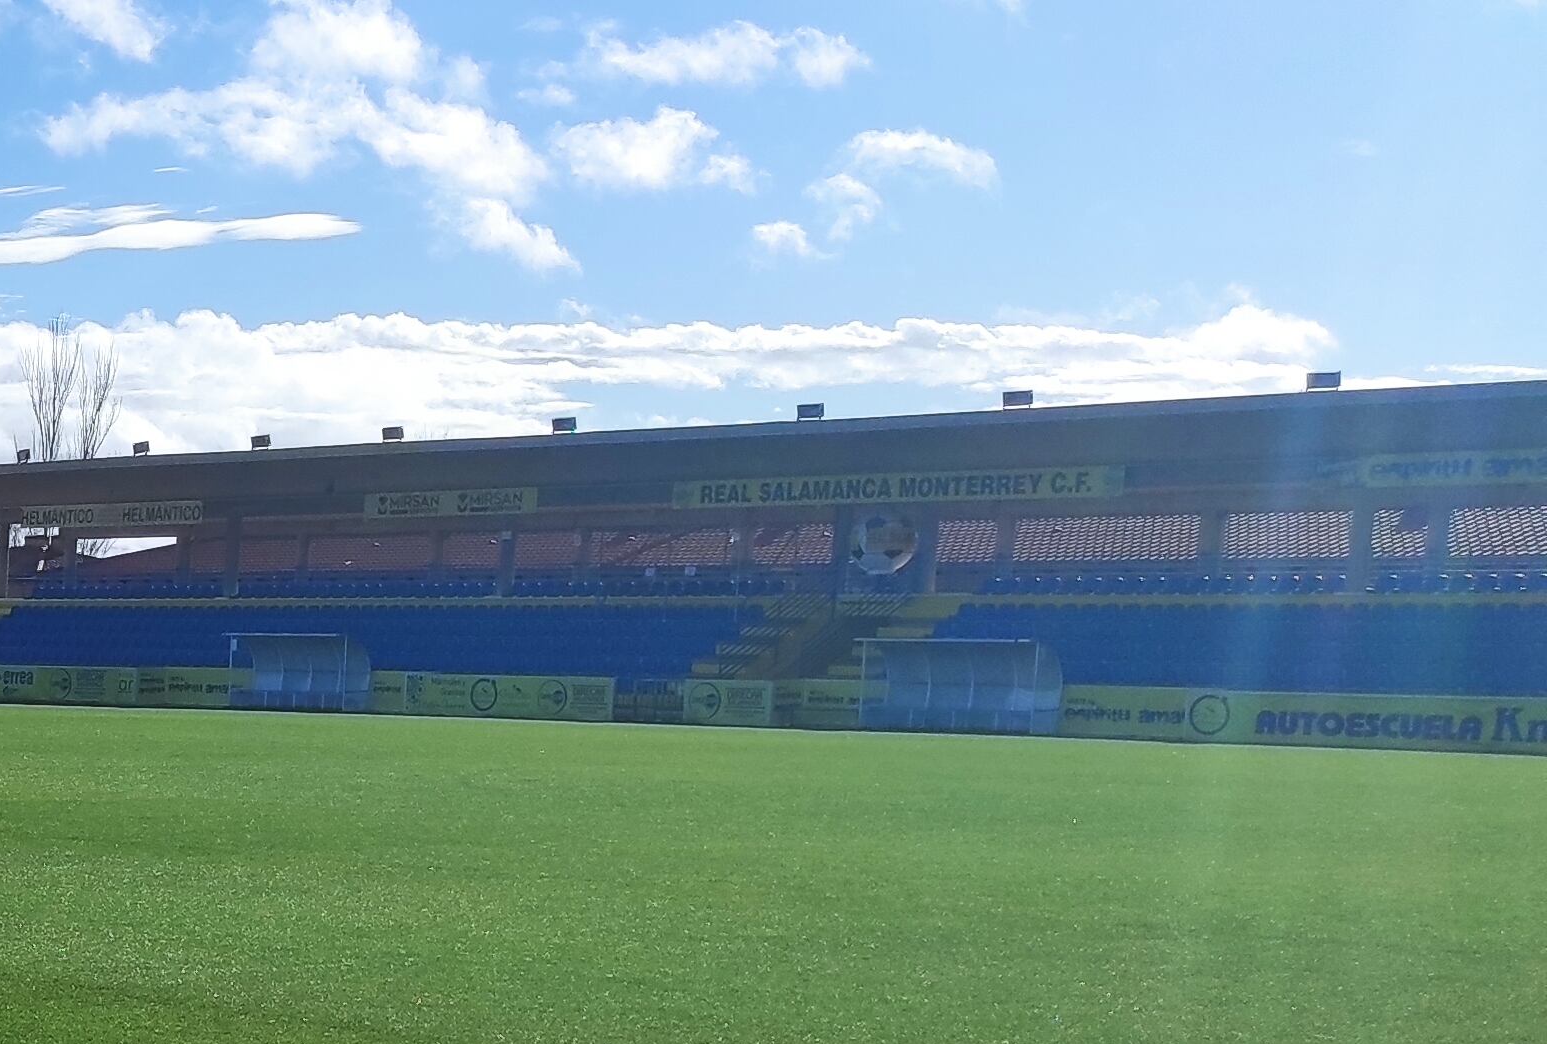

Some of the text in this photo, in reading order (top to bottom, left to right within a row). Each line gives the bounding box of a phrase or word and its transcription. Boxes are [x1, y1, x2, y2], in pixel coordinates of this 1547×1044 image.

[470, 491, 523, 505] MIRSAN
[700, 472, 1092, 504] REAL SALAMANCA MONTERREY C.F.
[389, 494, 440, 508] MIRSAN
[1255, 710, 1483, 741] AUTOESCUELA
